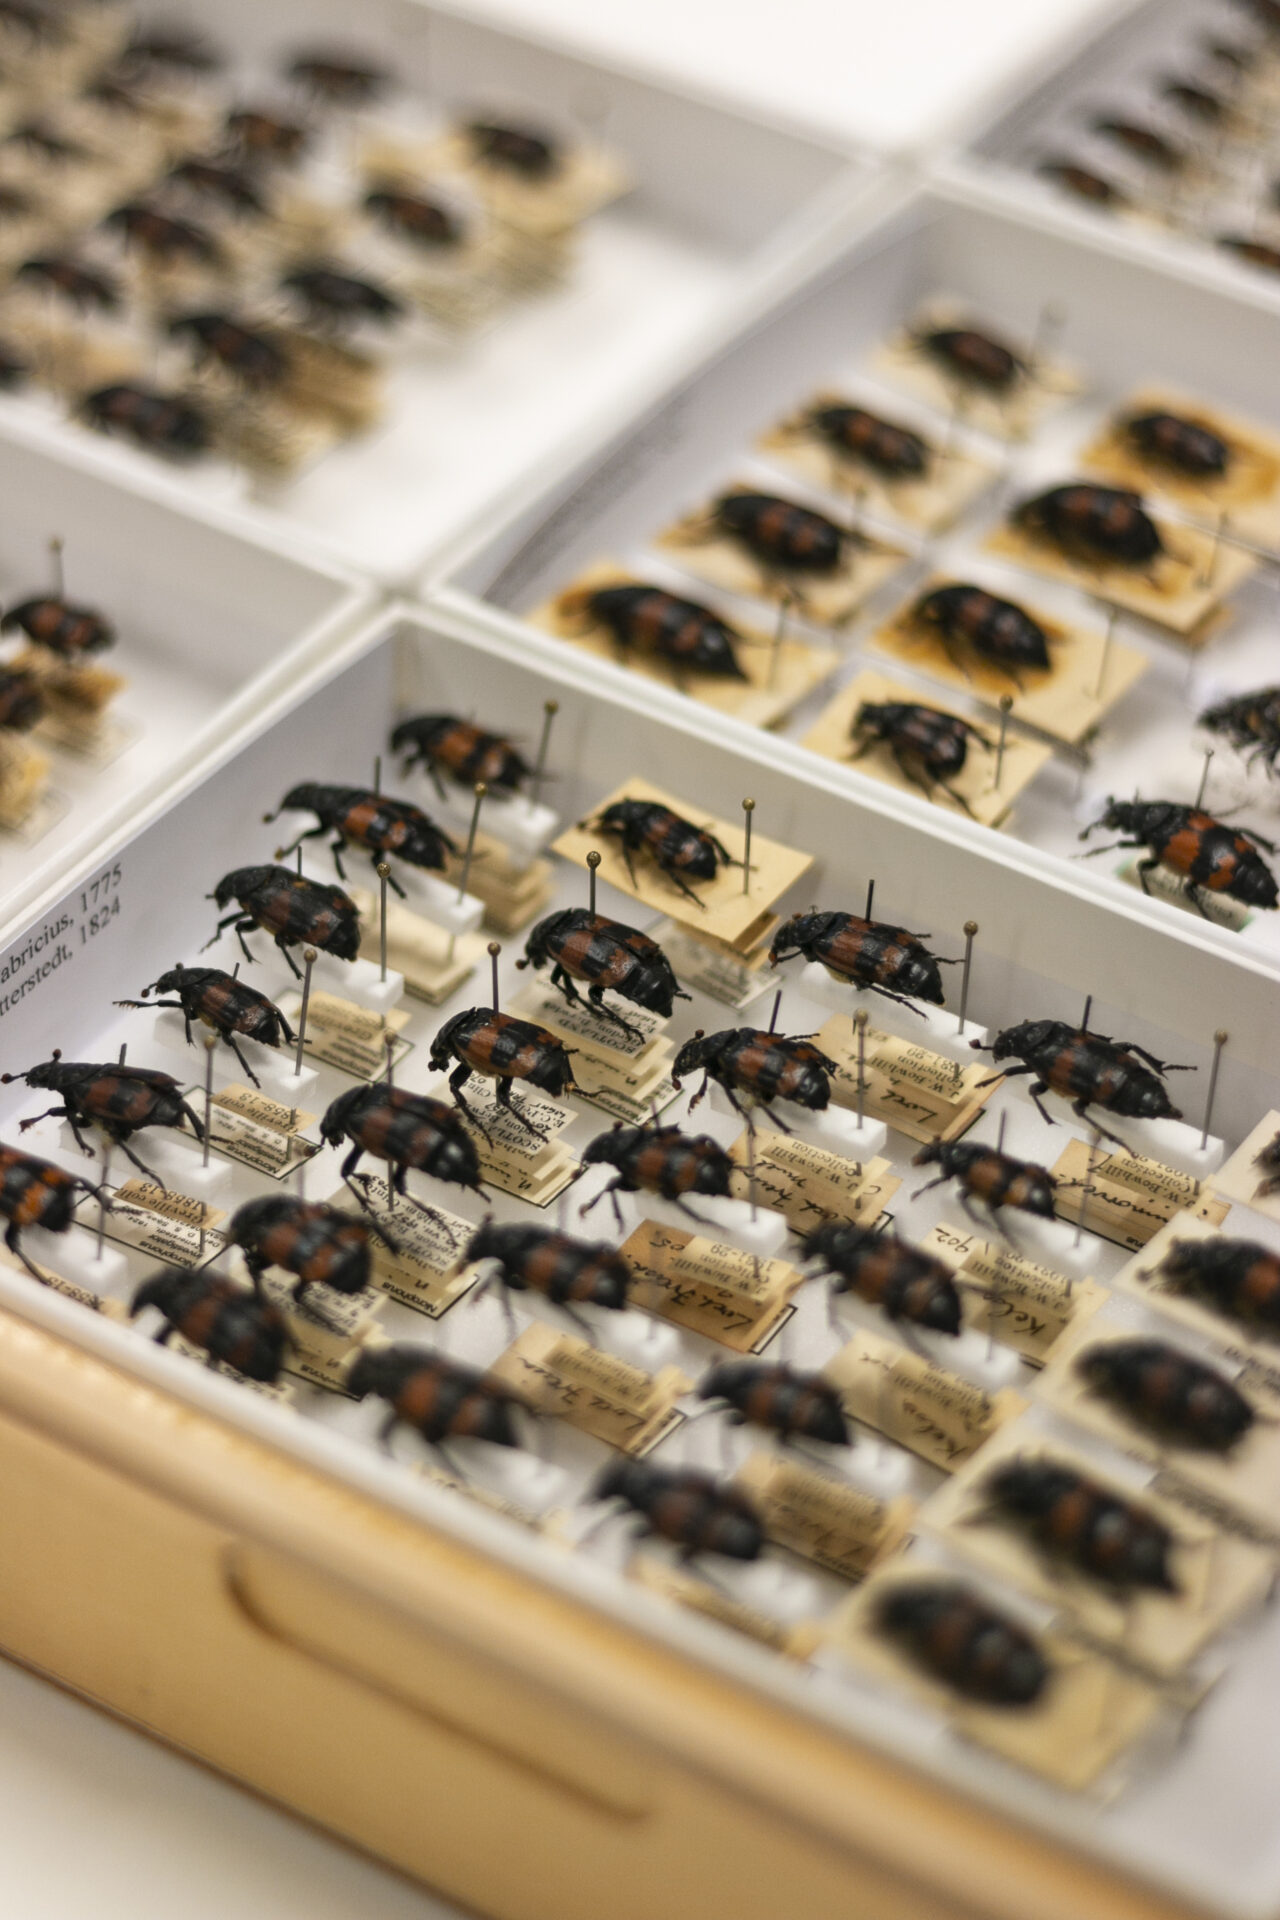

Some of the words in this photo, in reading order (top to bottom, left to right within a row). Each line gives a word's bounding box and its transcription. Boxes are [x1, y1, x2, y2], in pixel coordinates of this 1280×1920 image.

[81, 862, 122, 913] 1775
[81, 895, 120, 945] 1824
[791, 1141, 857, 1177] Collection
[1121, 1158, 1191, 1194] Collection
[1104, 1164, 1163, 1195] Bowhill
[139, 1240, 197, 1270] Nicrophorus
[381, 1280, 438, 1314] Nicrophorus
